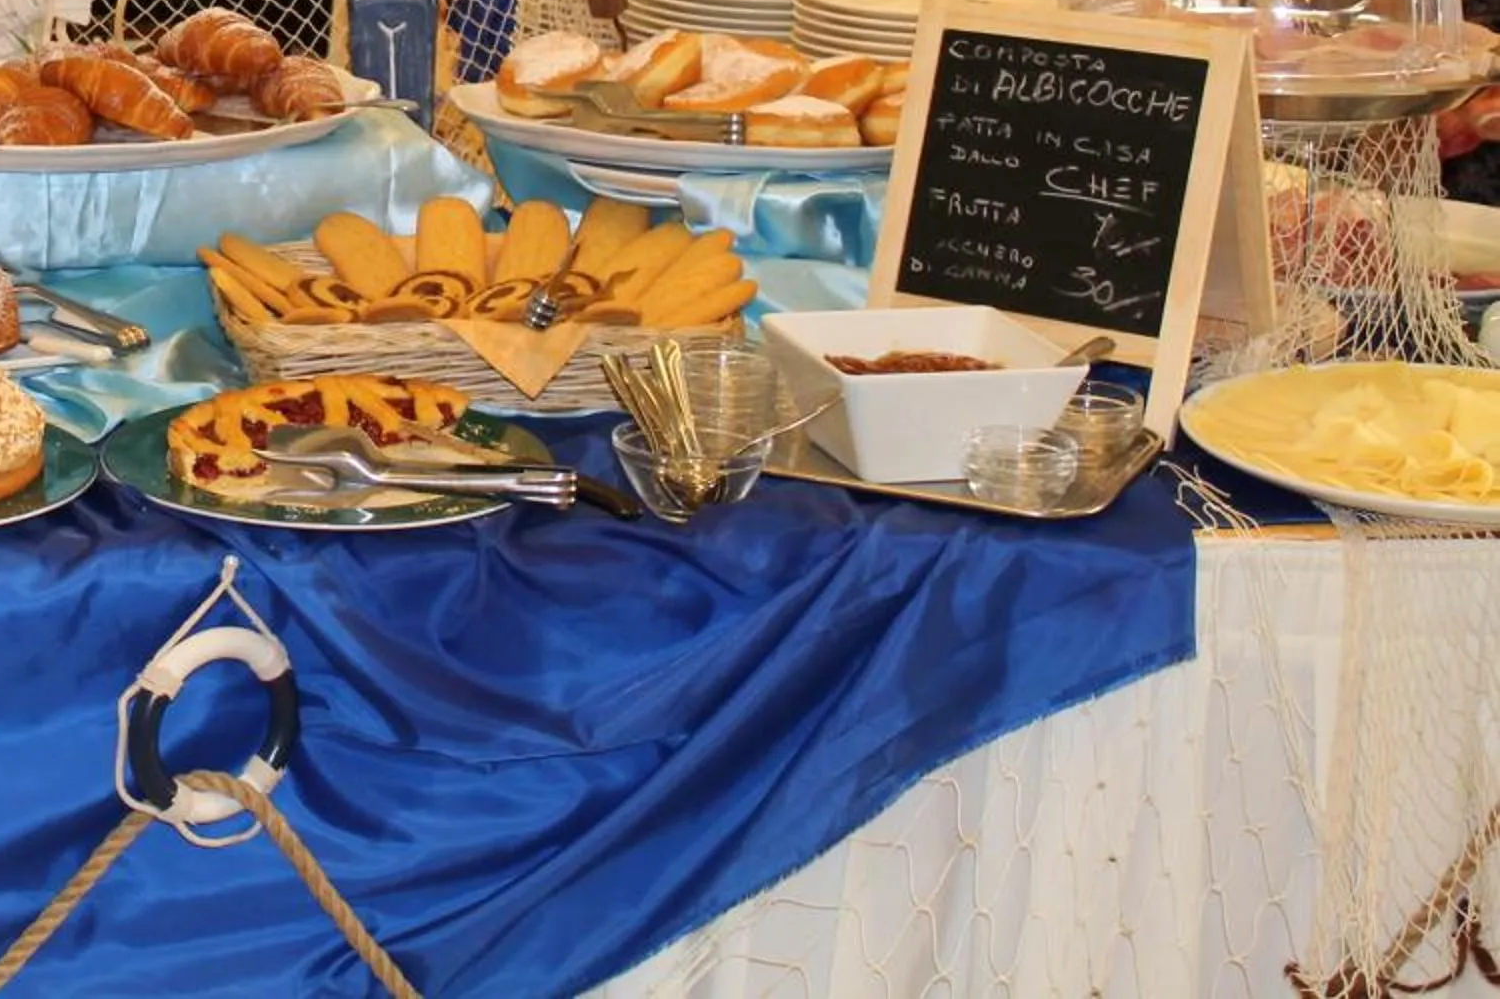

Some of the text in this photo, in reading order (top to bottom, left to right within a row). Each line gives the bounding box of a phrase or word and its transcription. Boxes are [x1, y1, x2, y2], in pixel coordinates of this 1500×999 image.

[948, 39, 1106, 73] COMPOSTA
[951, 68, 1192, 122] DI ALBICOCCHE
[1036, 131, 1061, 149] IN
[950, 144, 1160, 202] DALLO CHEF
[929, 187, 1020, 224] FRUTTA
